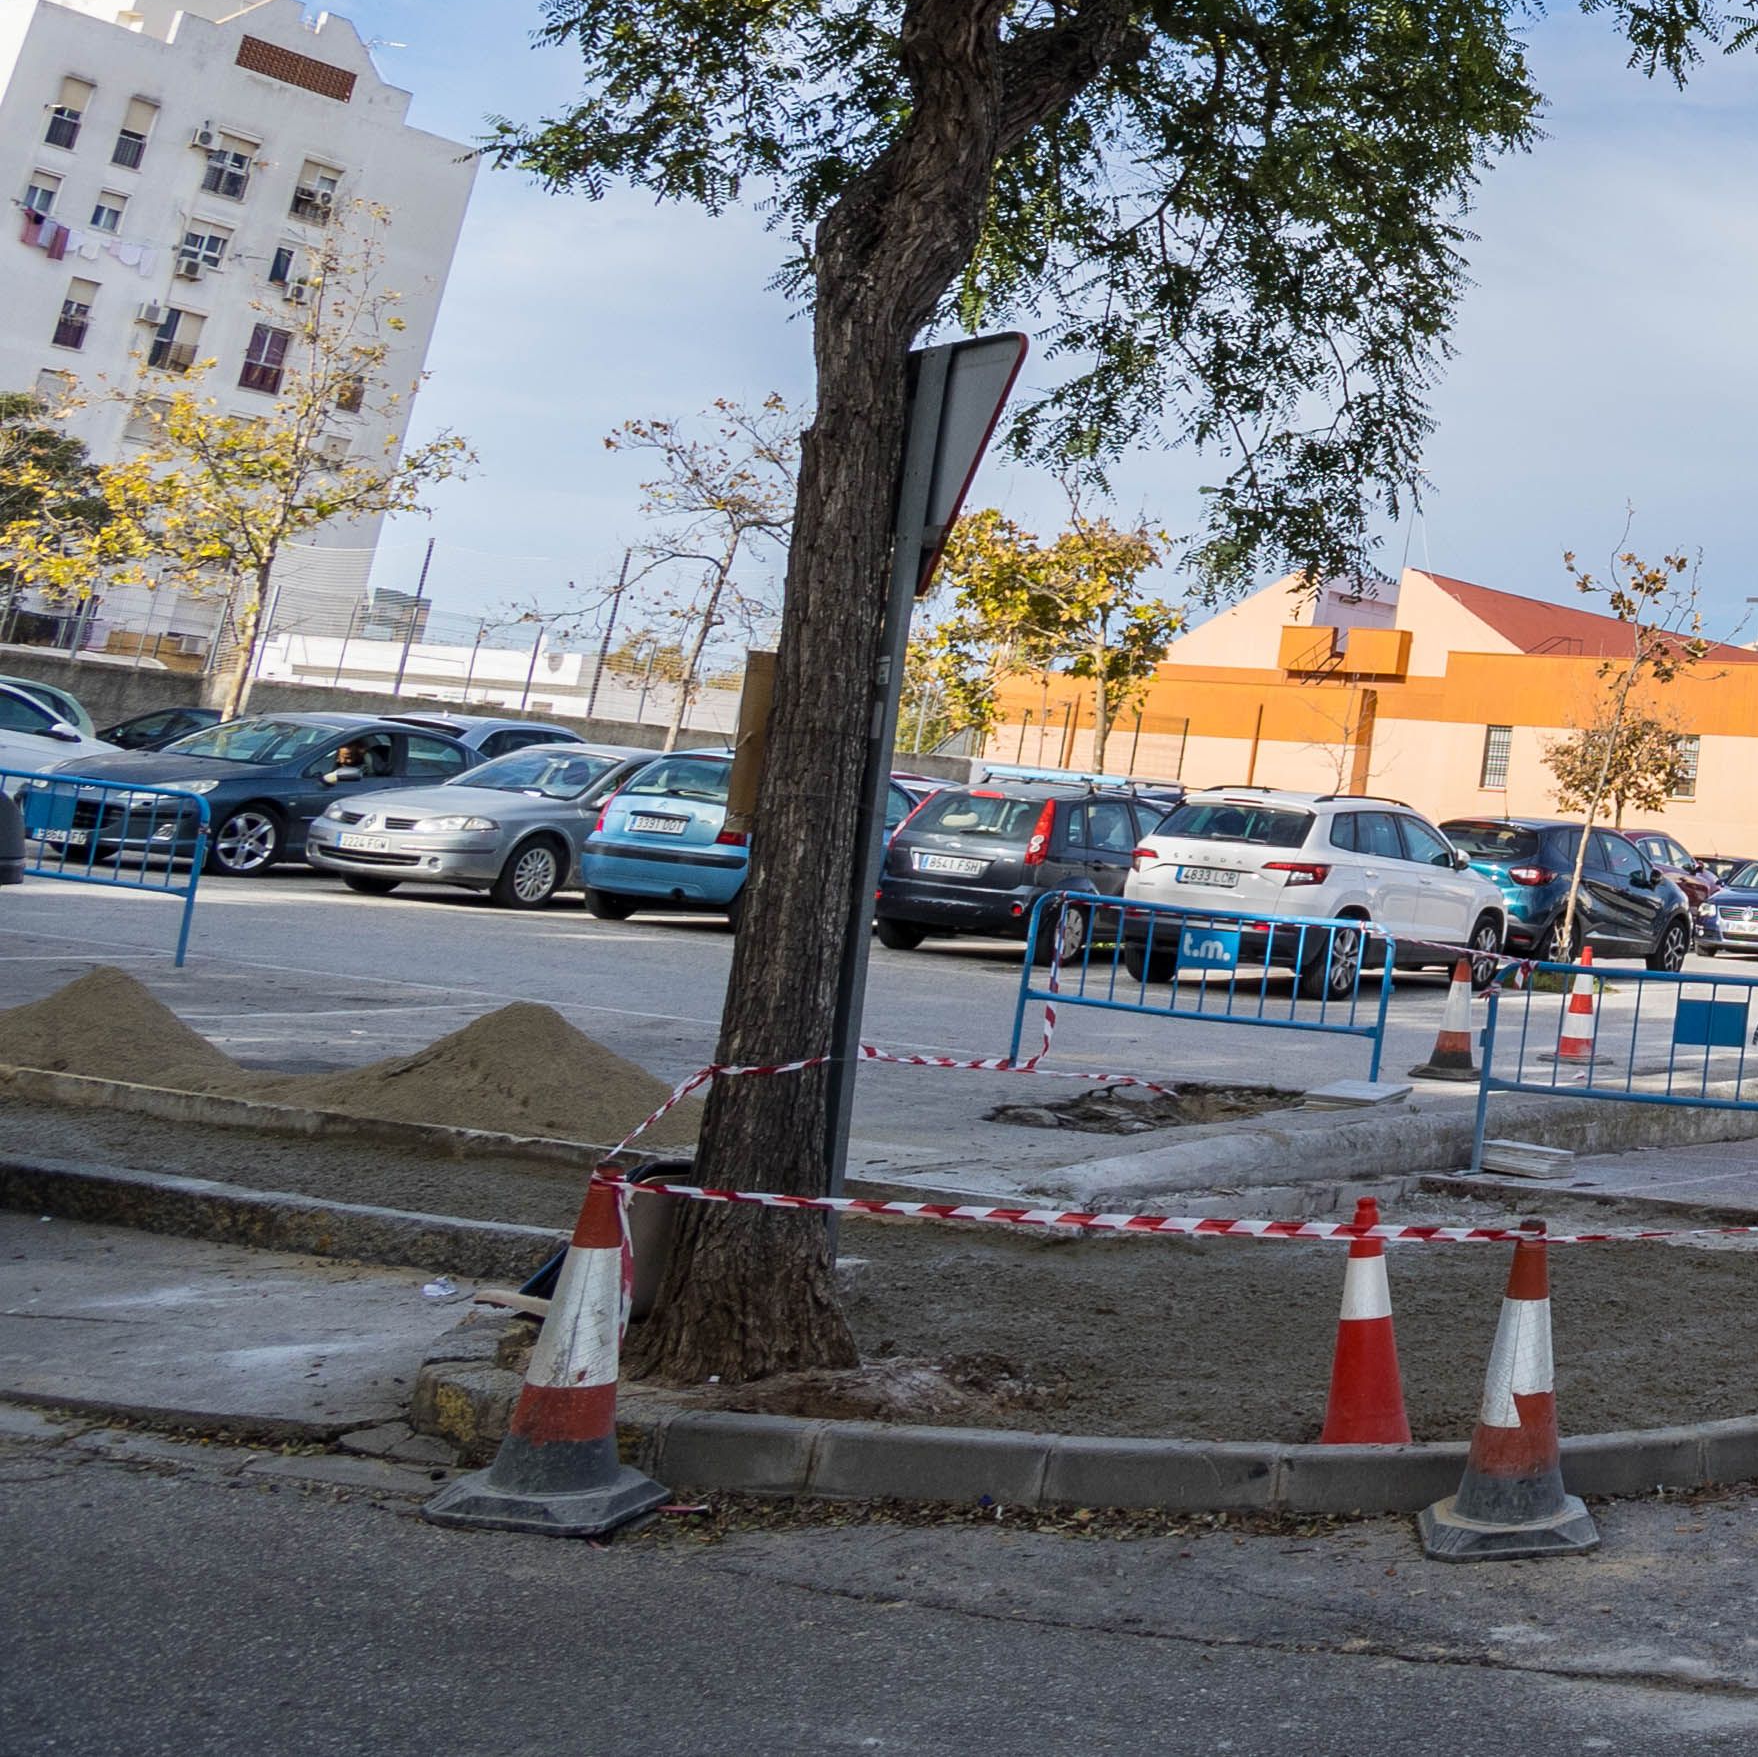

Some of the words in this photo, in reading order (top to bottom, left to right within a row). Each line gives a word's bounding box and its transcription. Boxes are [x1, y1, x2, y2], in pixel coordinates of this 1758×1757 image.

[1184, 869, 1211, 881] 4833
[1214, 872, 1236, 883] LCR
[1184, 932, 1231, 961] t.m.
